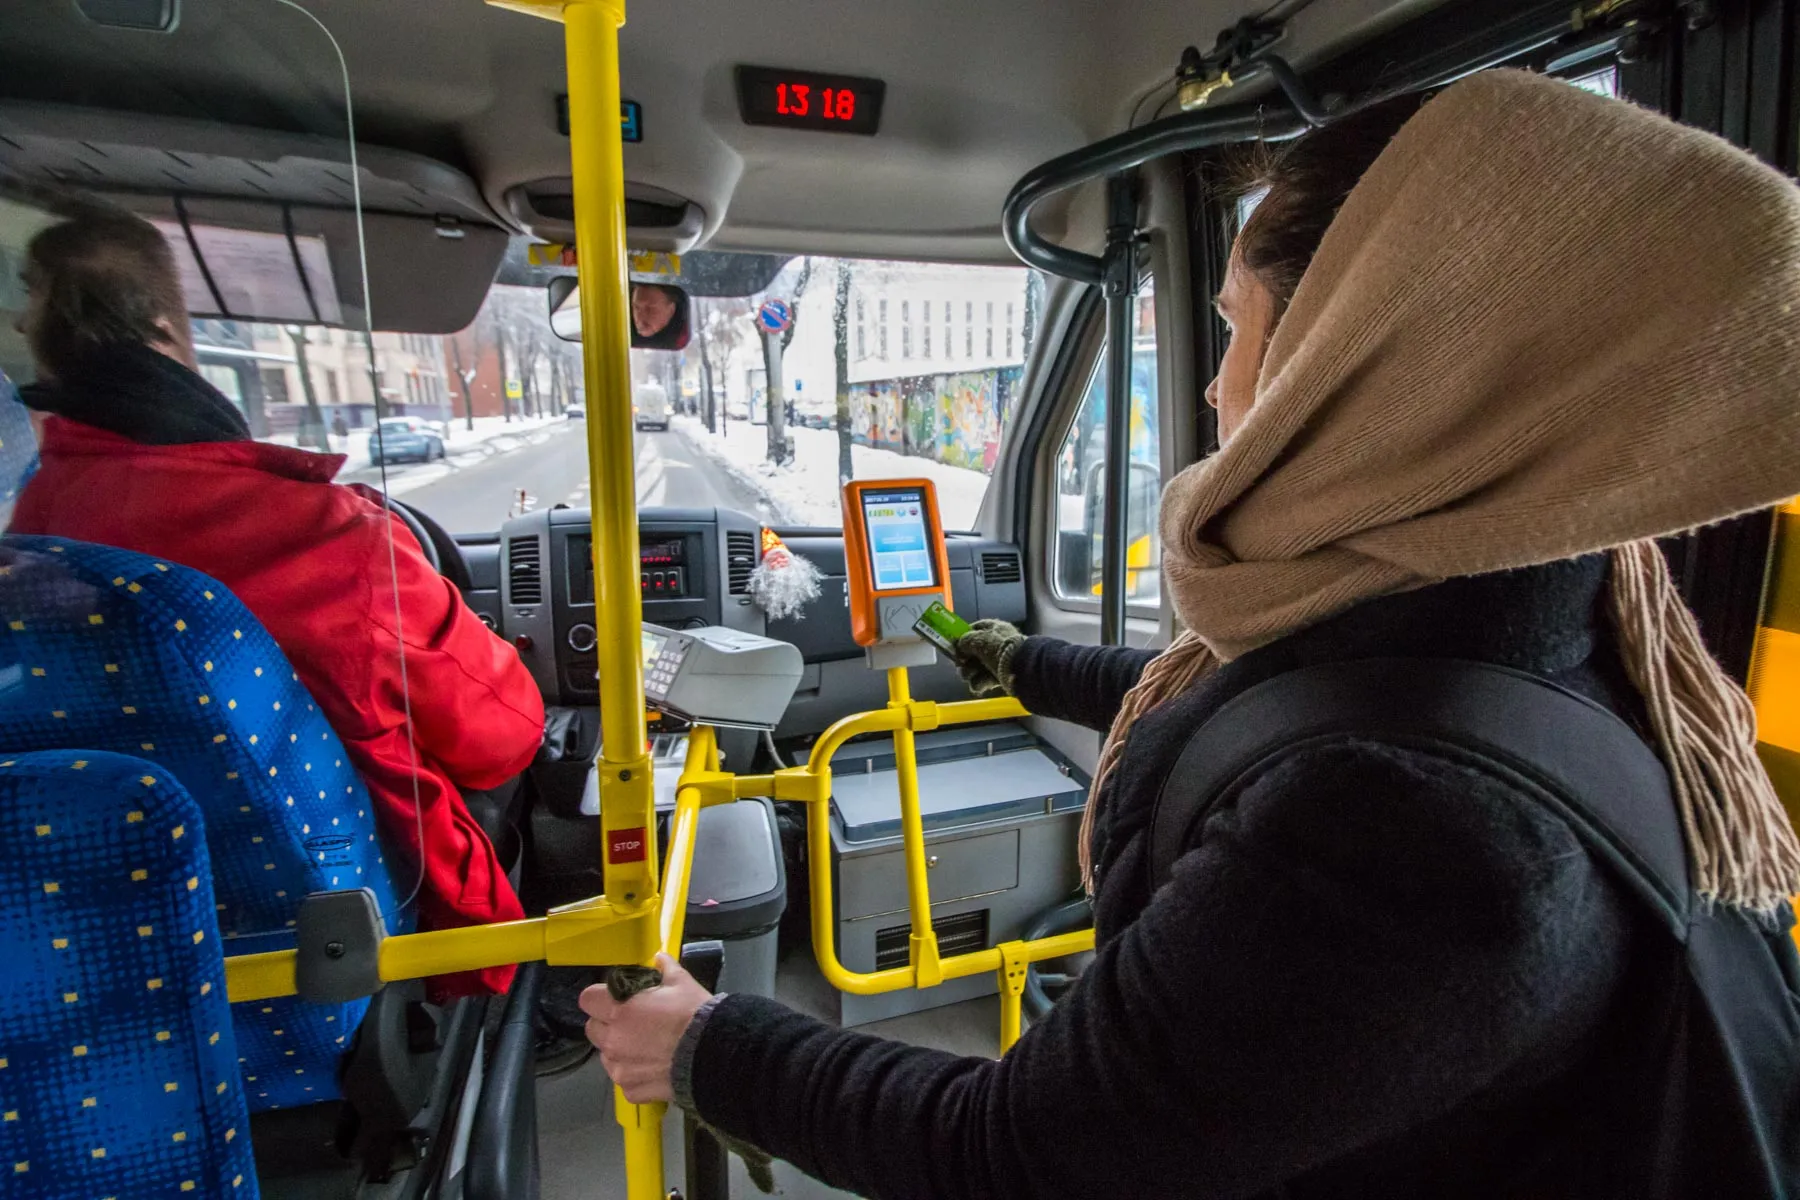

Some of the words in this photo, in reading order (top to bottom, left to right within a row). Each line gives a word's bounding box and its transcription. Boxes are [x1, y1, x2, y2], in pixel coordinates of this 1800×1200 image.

[776, 83, 809, 116] 13
[822, 88, 855, 120] 18
[613, 841, 641, 851] STOP
